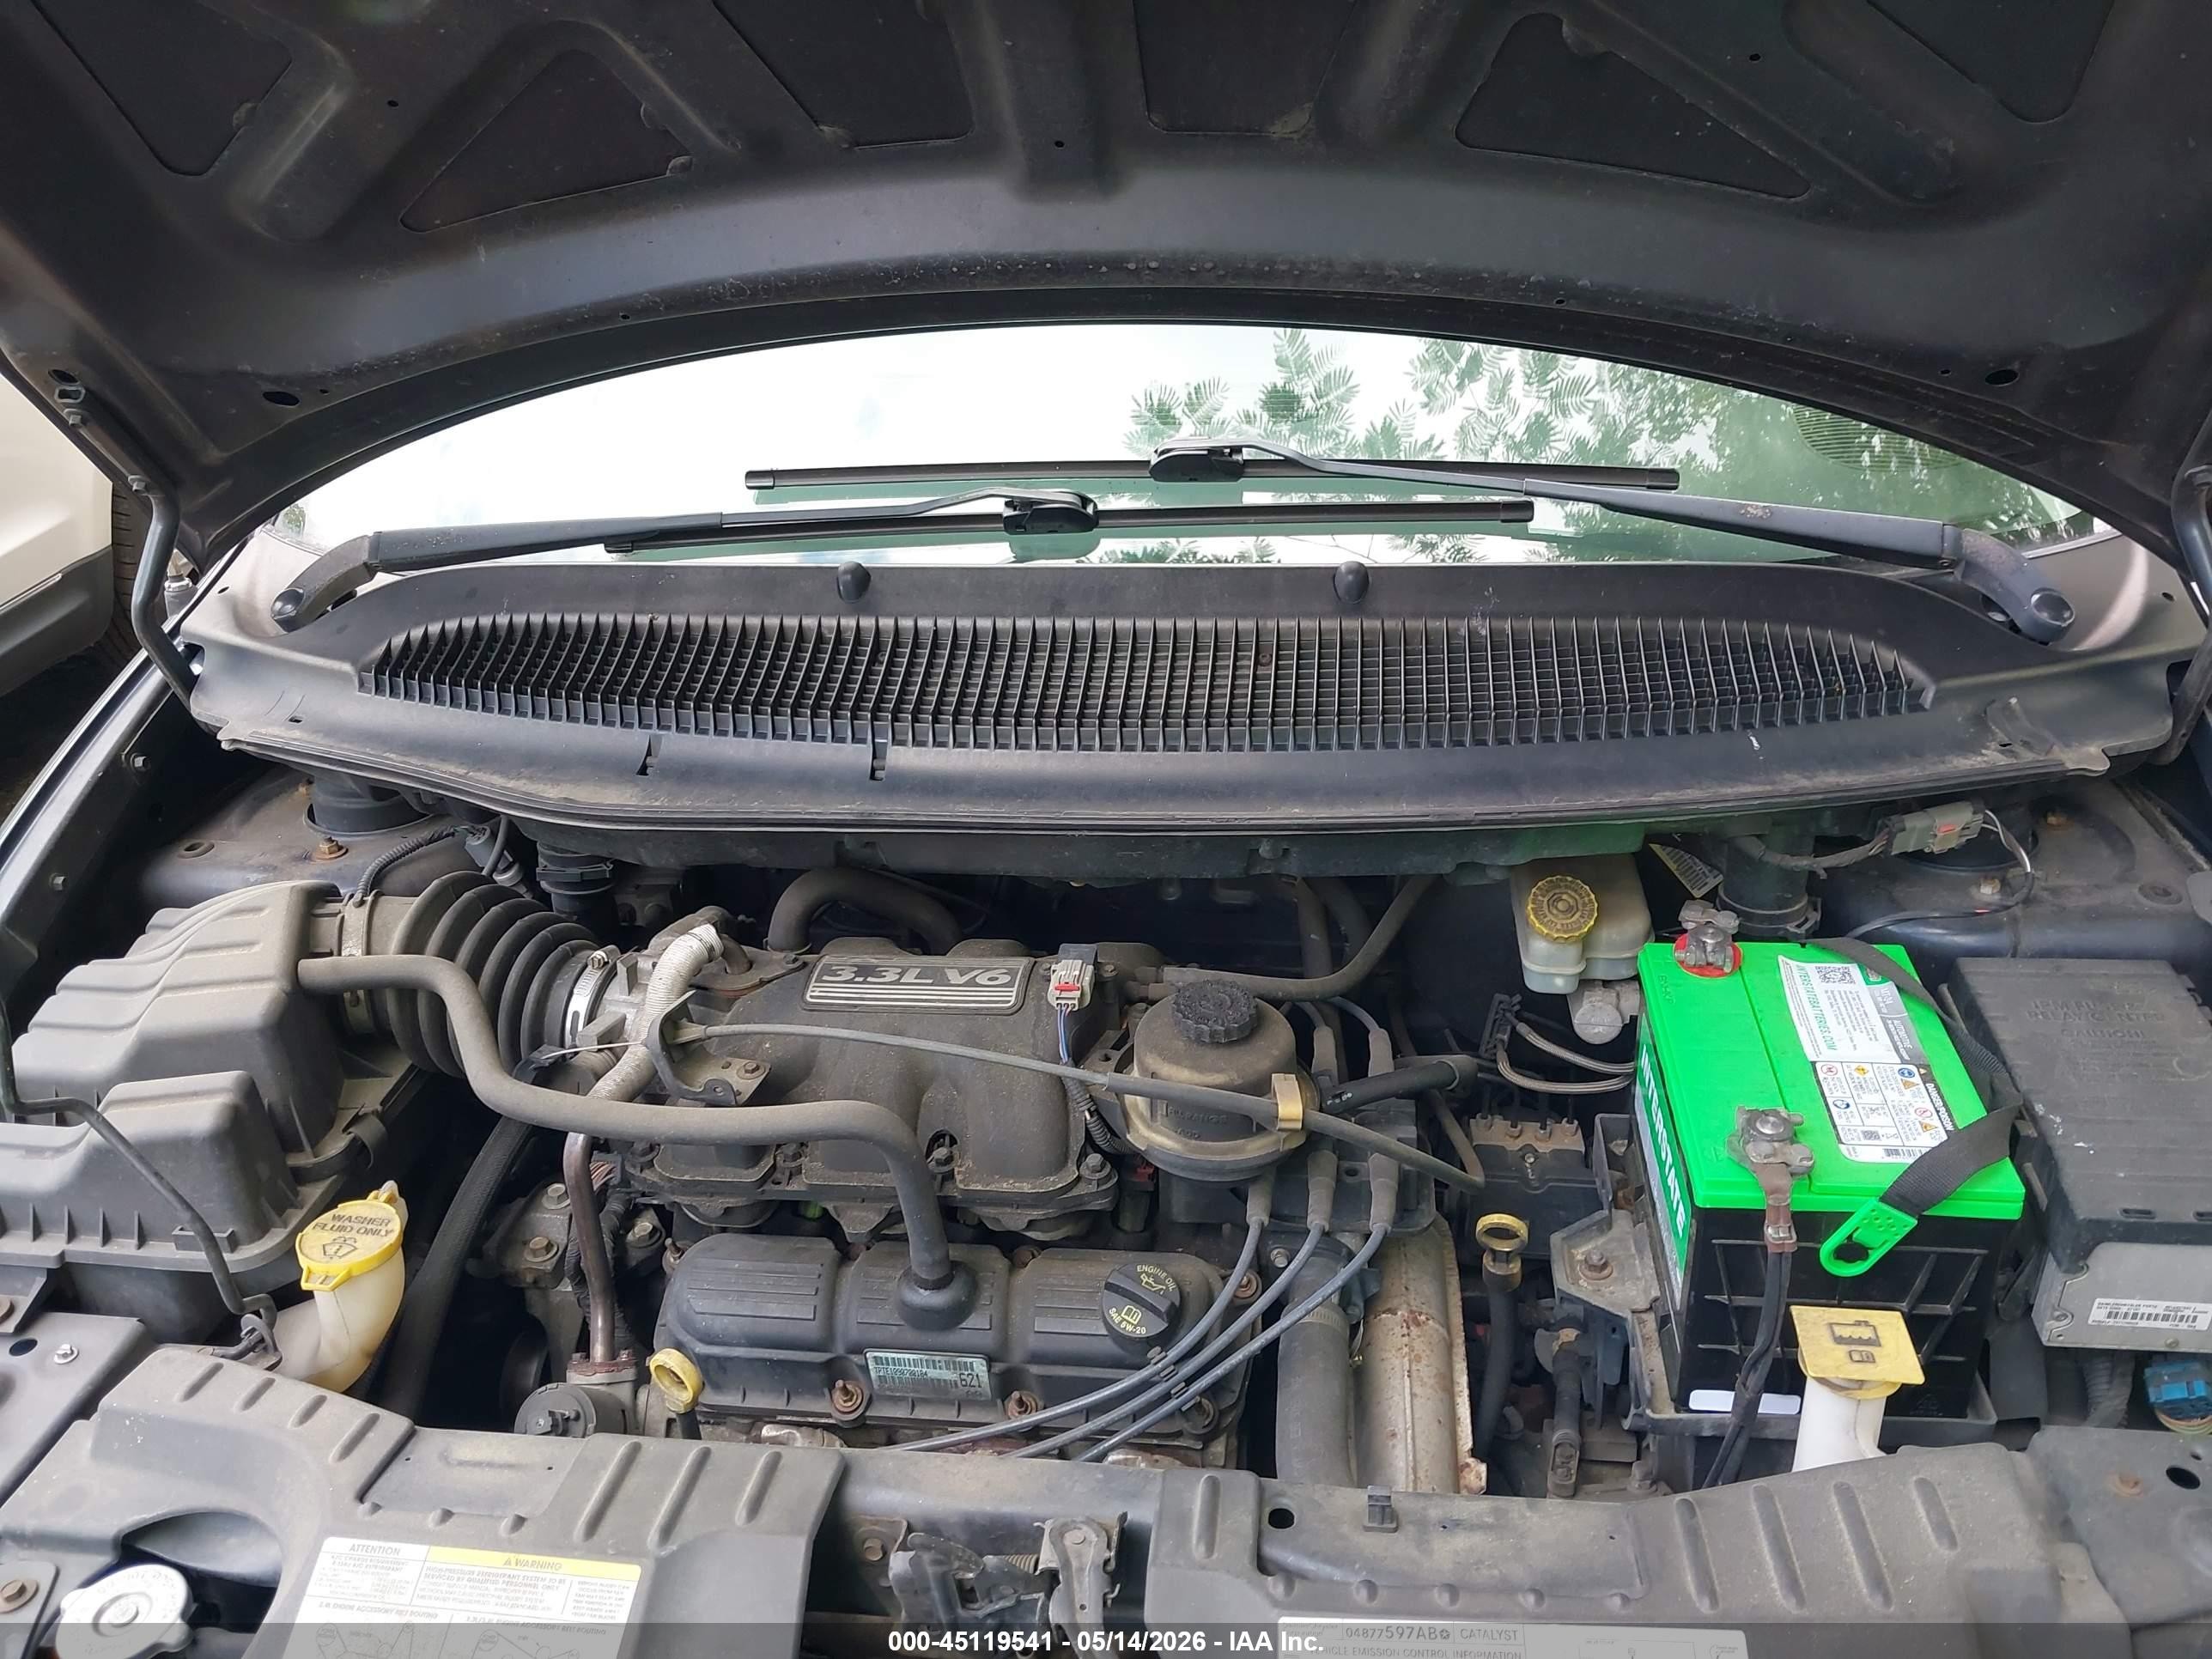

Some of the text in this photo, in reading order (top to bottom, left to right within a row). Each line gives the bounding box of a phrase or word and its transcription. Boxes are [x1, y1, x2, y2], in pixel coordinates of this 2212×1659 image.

[822, 966, 1012, 986] 3.3L V6
[1641, 1043, 1686, 1238] INTERSTATE
[331, 1214, 392, 1227] WASHER
[312, 1222, 393, 1237] FLUID ONLY
[1137, 1264, 1177, 1291] ENGINE OIL
[1109, 1307, 1146, 1334] SAE 5W-20
[349, 1543, 400, 1556] ATTENTION
[514, 1557, 562, 1571] WARNING
[1460, 1628, 1519, 1642] CATALYST
